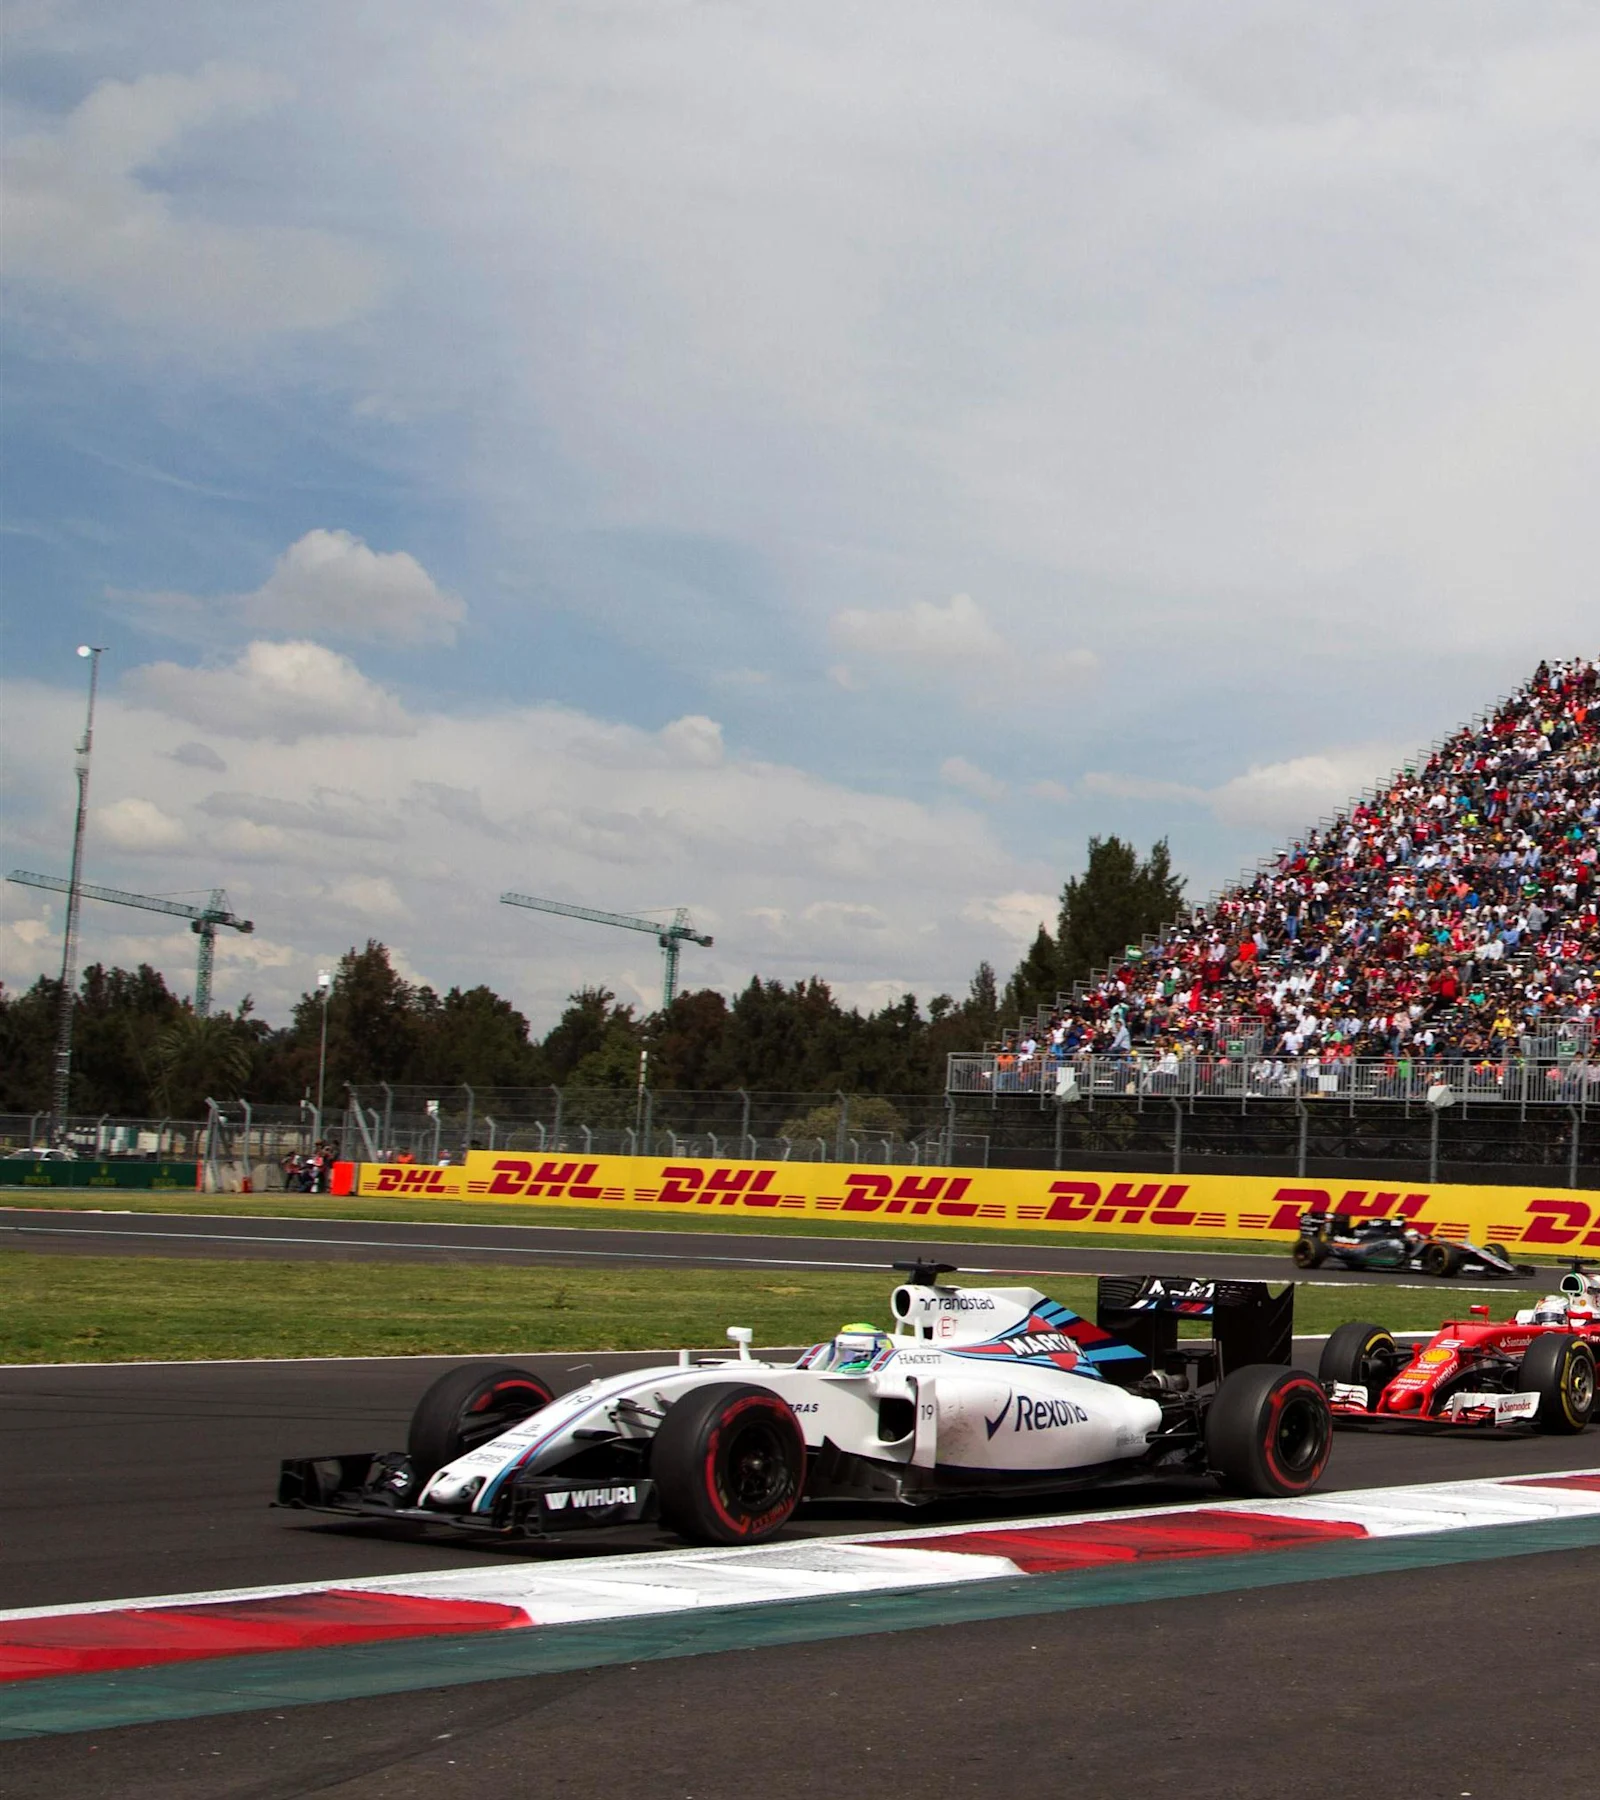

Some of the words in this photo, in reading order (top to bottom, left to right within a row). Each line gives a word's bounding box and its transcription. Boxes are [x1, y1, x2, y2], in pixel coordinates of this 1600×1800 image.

[377, 1169, 446, 1193] DHL
[488, 1160, 603, 1199] DHL
[658, 1167, 782, 1208] DHL
[841, 1174, 980, 1217] DHL
[1045, 1181, 1198, 1225] DHL
[1268, 1188, 1438, 1236] DHL
[938, 1297, 995, 1311] randstad
[899, 1353, 942, 1365] HACKETT
[921, 1404, 934, 1421] 19
[1014, 1395, 1088, 1432] Rexona
[1503, 1400, 1531, 1412] Santander
[571, 1487, 637, 1504] WIHURI
